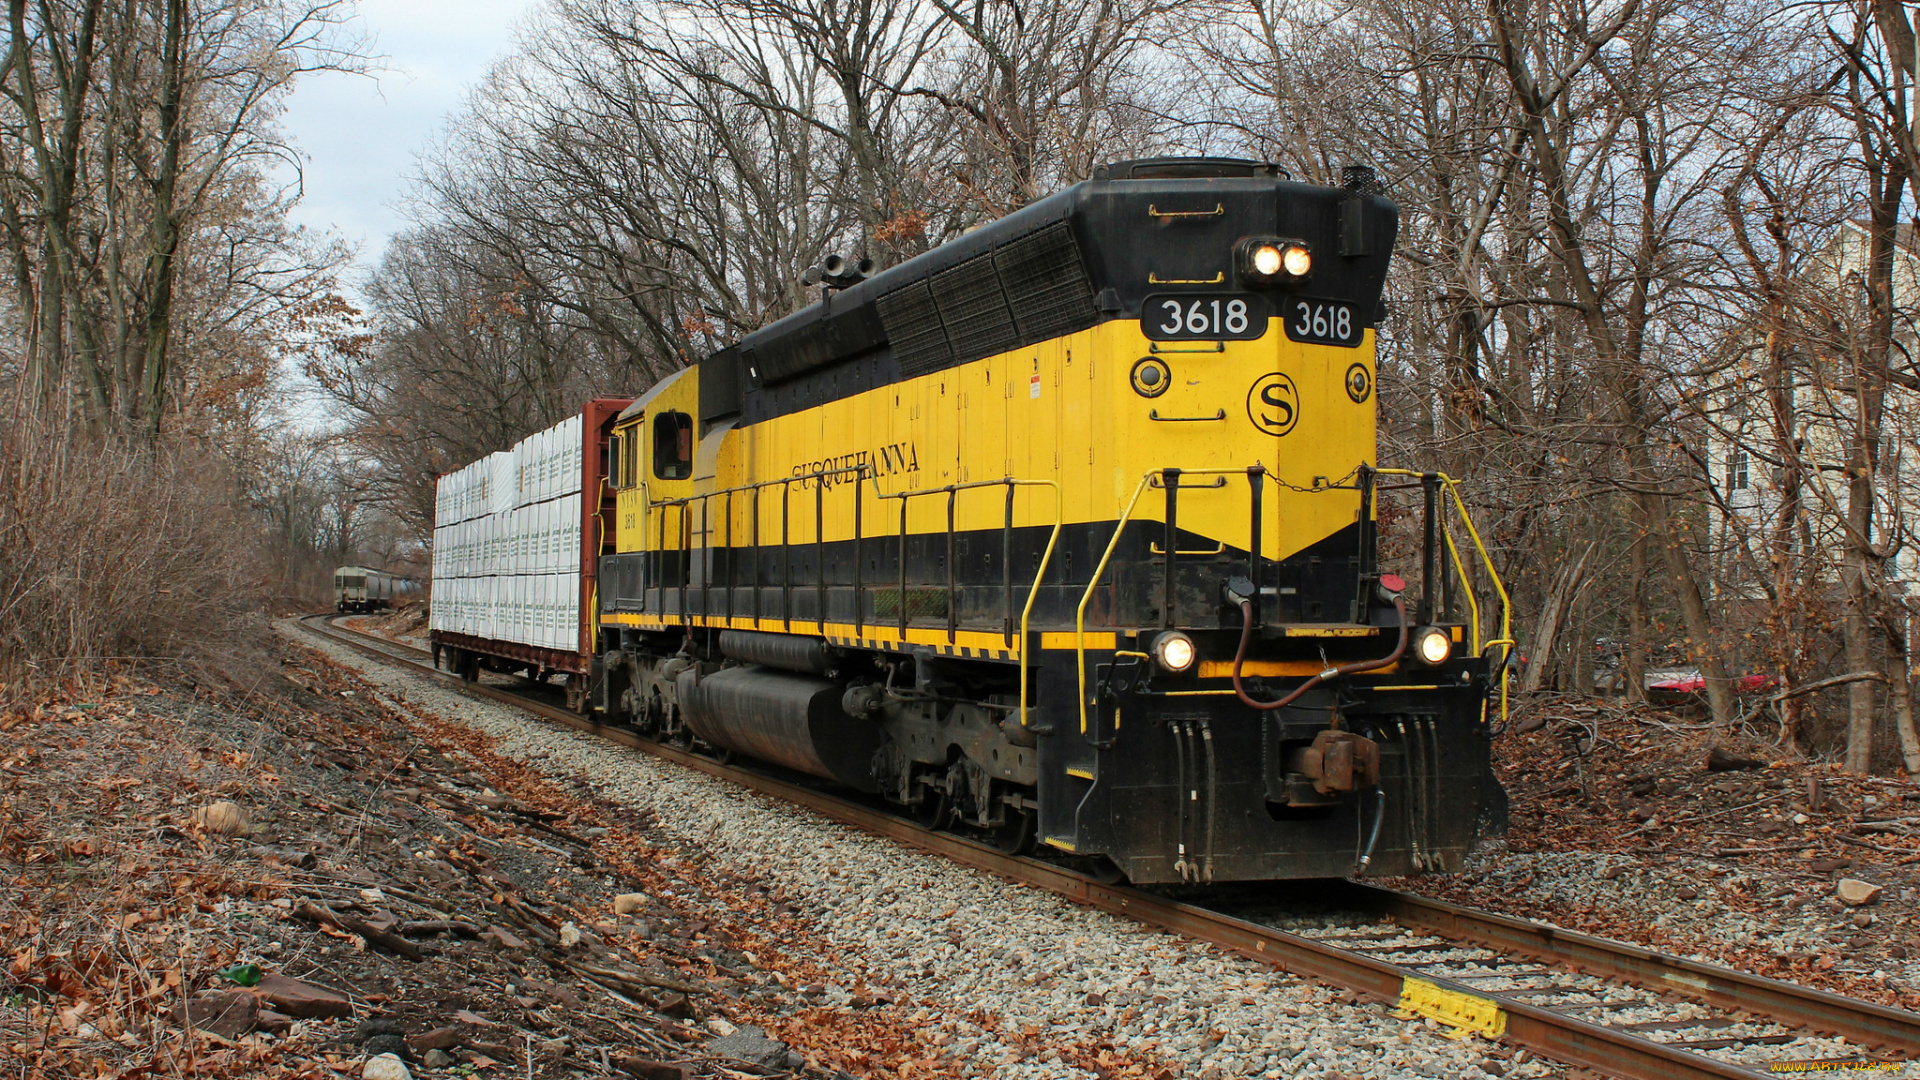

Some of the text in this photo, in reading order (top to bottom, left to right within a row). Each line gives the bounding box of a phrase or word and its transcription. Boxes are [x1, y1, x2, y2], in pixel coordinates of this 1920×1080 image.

[1160, 299, 1249, 335] 3618
[1295, 301, 1352, 340] 3618
[1260, 383, 1294, 427] S
[792, 440, 920, 493] SUSQUEHANNA
